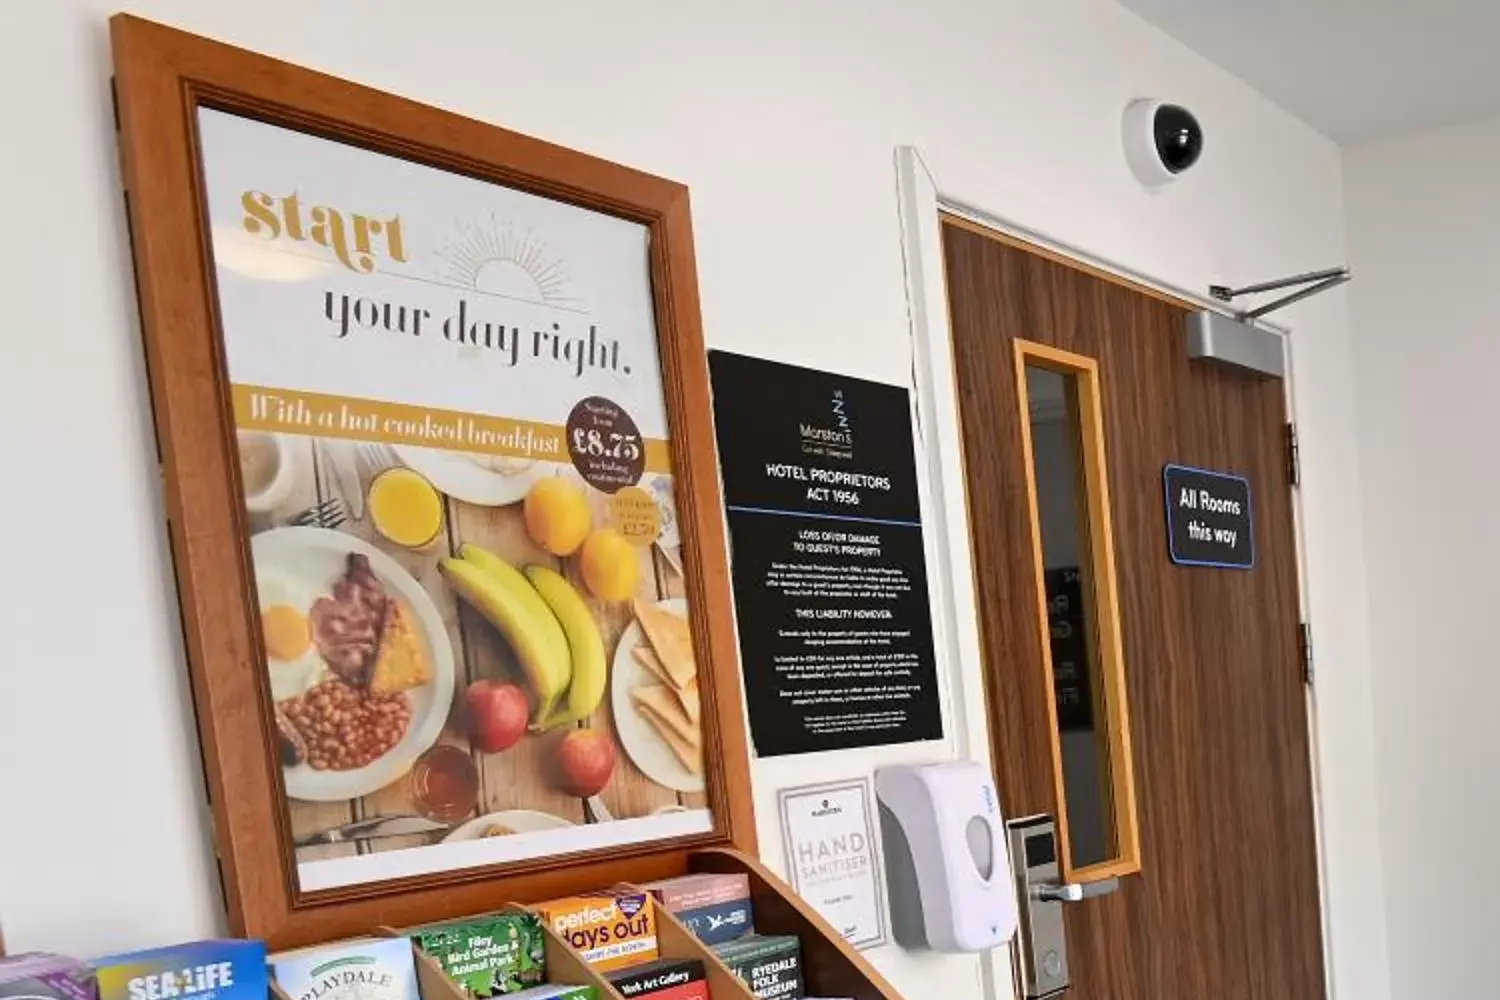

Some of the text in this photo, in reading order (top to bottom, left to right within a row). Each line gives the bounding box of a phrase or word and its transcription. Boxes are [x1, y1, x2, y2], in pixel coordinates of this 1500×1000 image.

[241, 190, 409, 273] start
[325, 290, 631, 377] your day right.
[249, 393, 560, 456] With a hot cooked breakfast
[573, 427, 639, 461] £8.75
[766, 463, 891, 491] HOTEL PROPRIETORS
[807, 487, 861, 505] ACT 1956
[1180, 487, 1241, 515] All Rooms
[1188, 520, 1237, 549] this way
[798, 832, 866, 863] HAND
[555, 904, 618, 931] perfect
[614, 914, 650, 937] out
[752, 957, 797, 978] RYEDALE
[753, 973, 780, 990] FOLK
[621, 971, 690, 995] York Art Gallery
